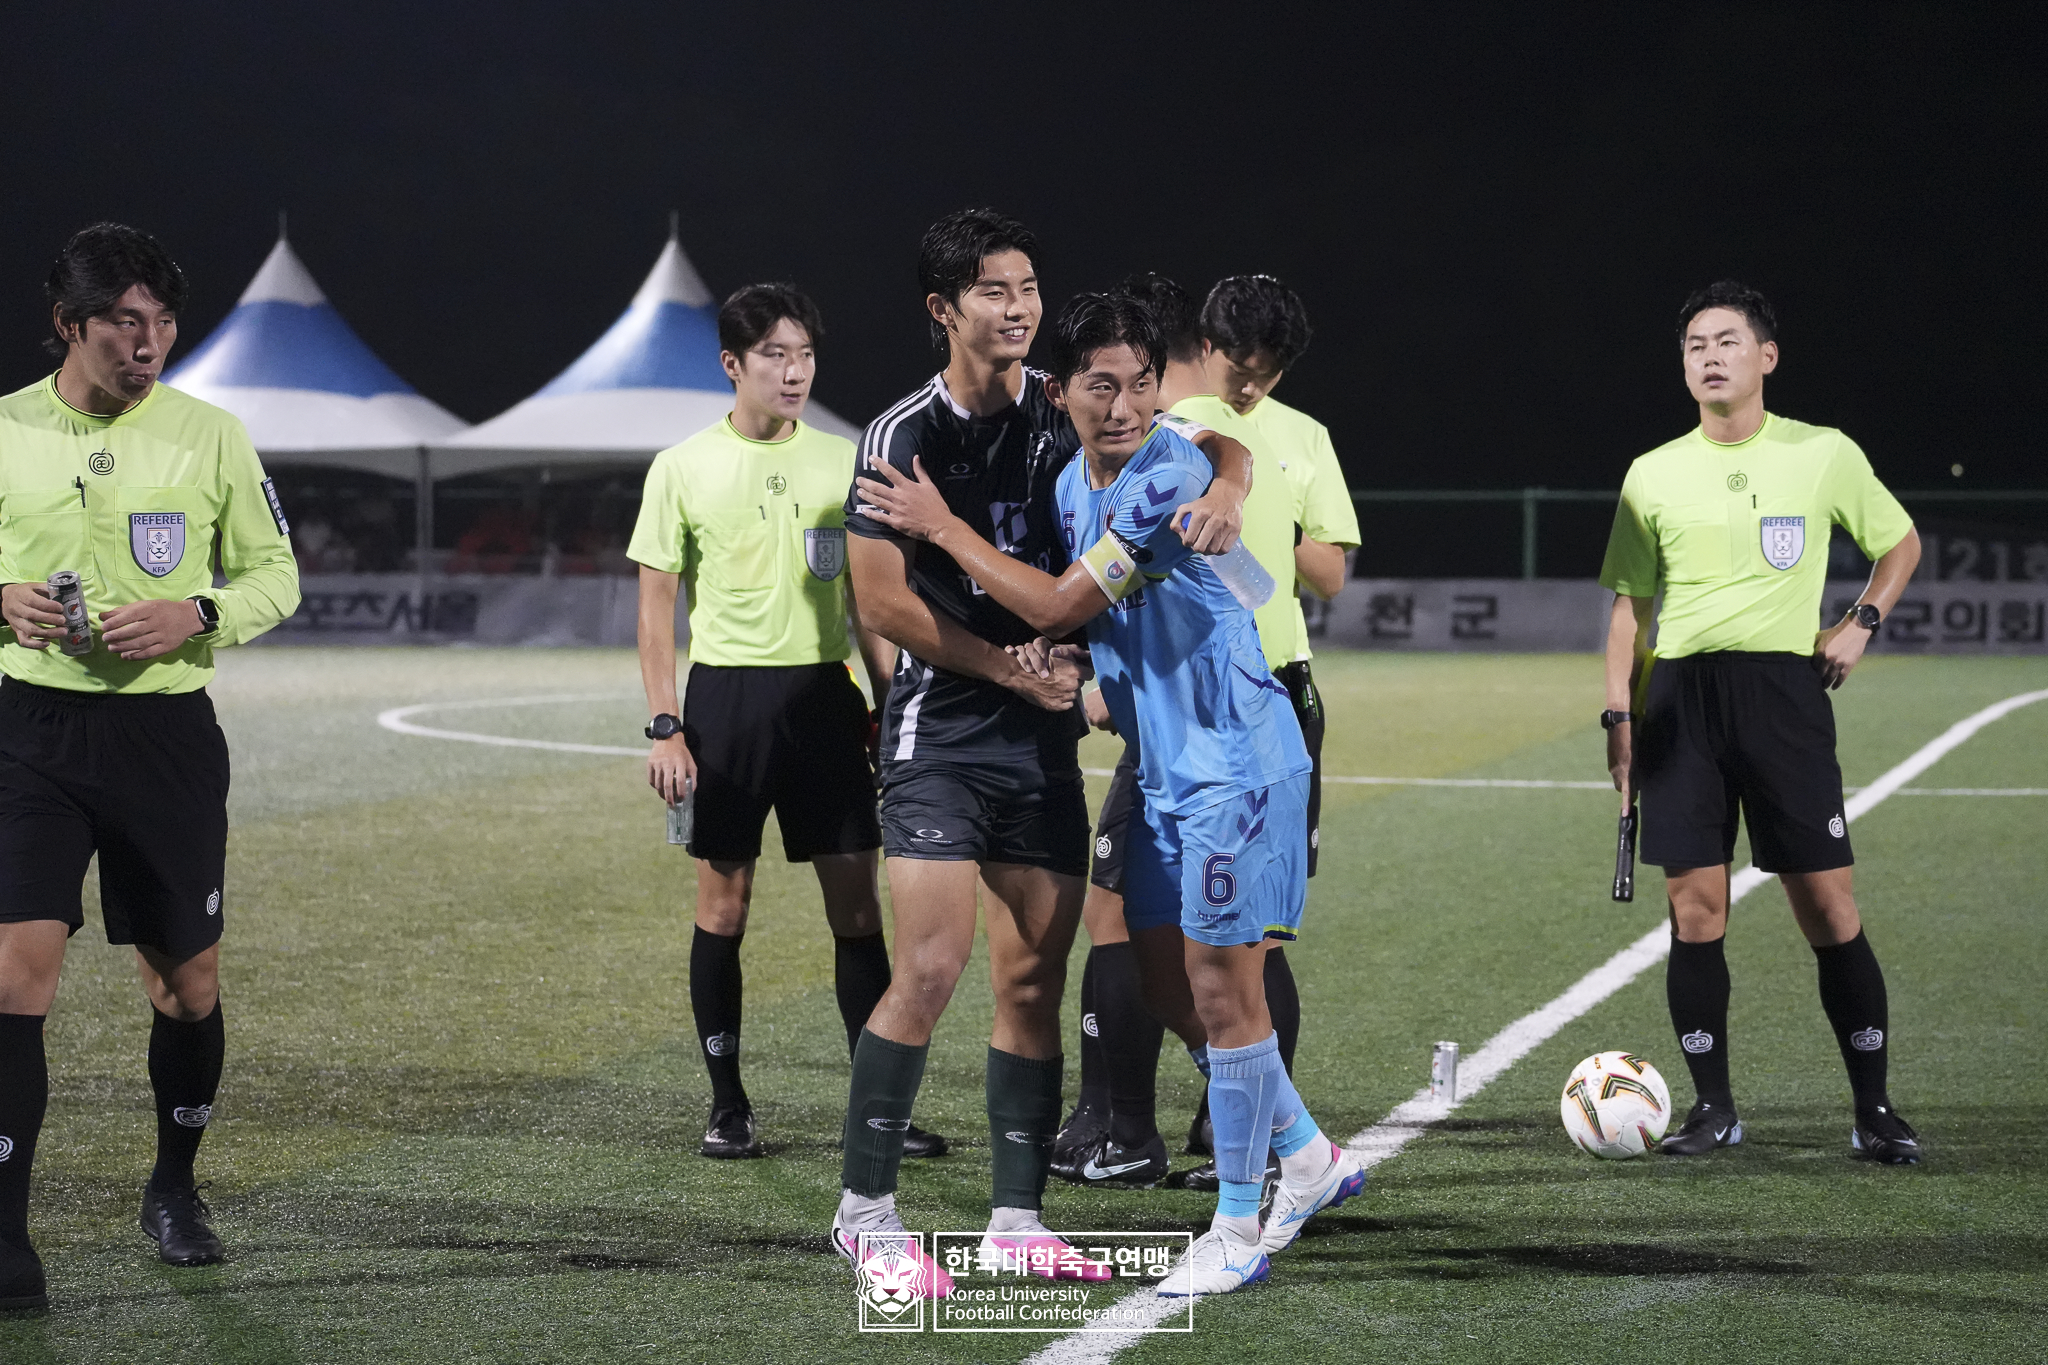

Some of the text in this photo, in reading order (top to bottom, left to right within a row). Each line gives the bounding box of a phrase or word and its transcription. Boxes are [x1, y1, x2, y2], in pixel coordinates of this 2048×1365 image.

[133, 515, 183, 525] REFEREE
[1762, 518, 1803, 527] REFEREE
[806, 530, 845, 539] REFEREE
[1202, 852, 1236, 907] 6
[1198, 909, 1242, 922] hummel
